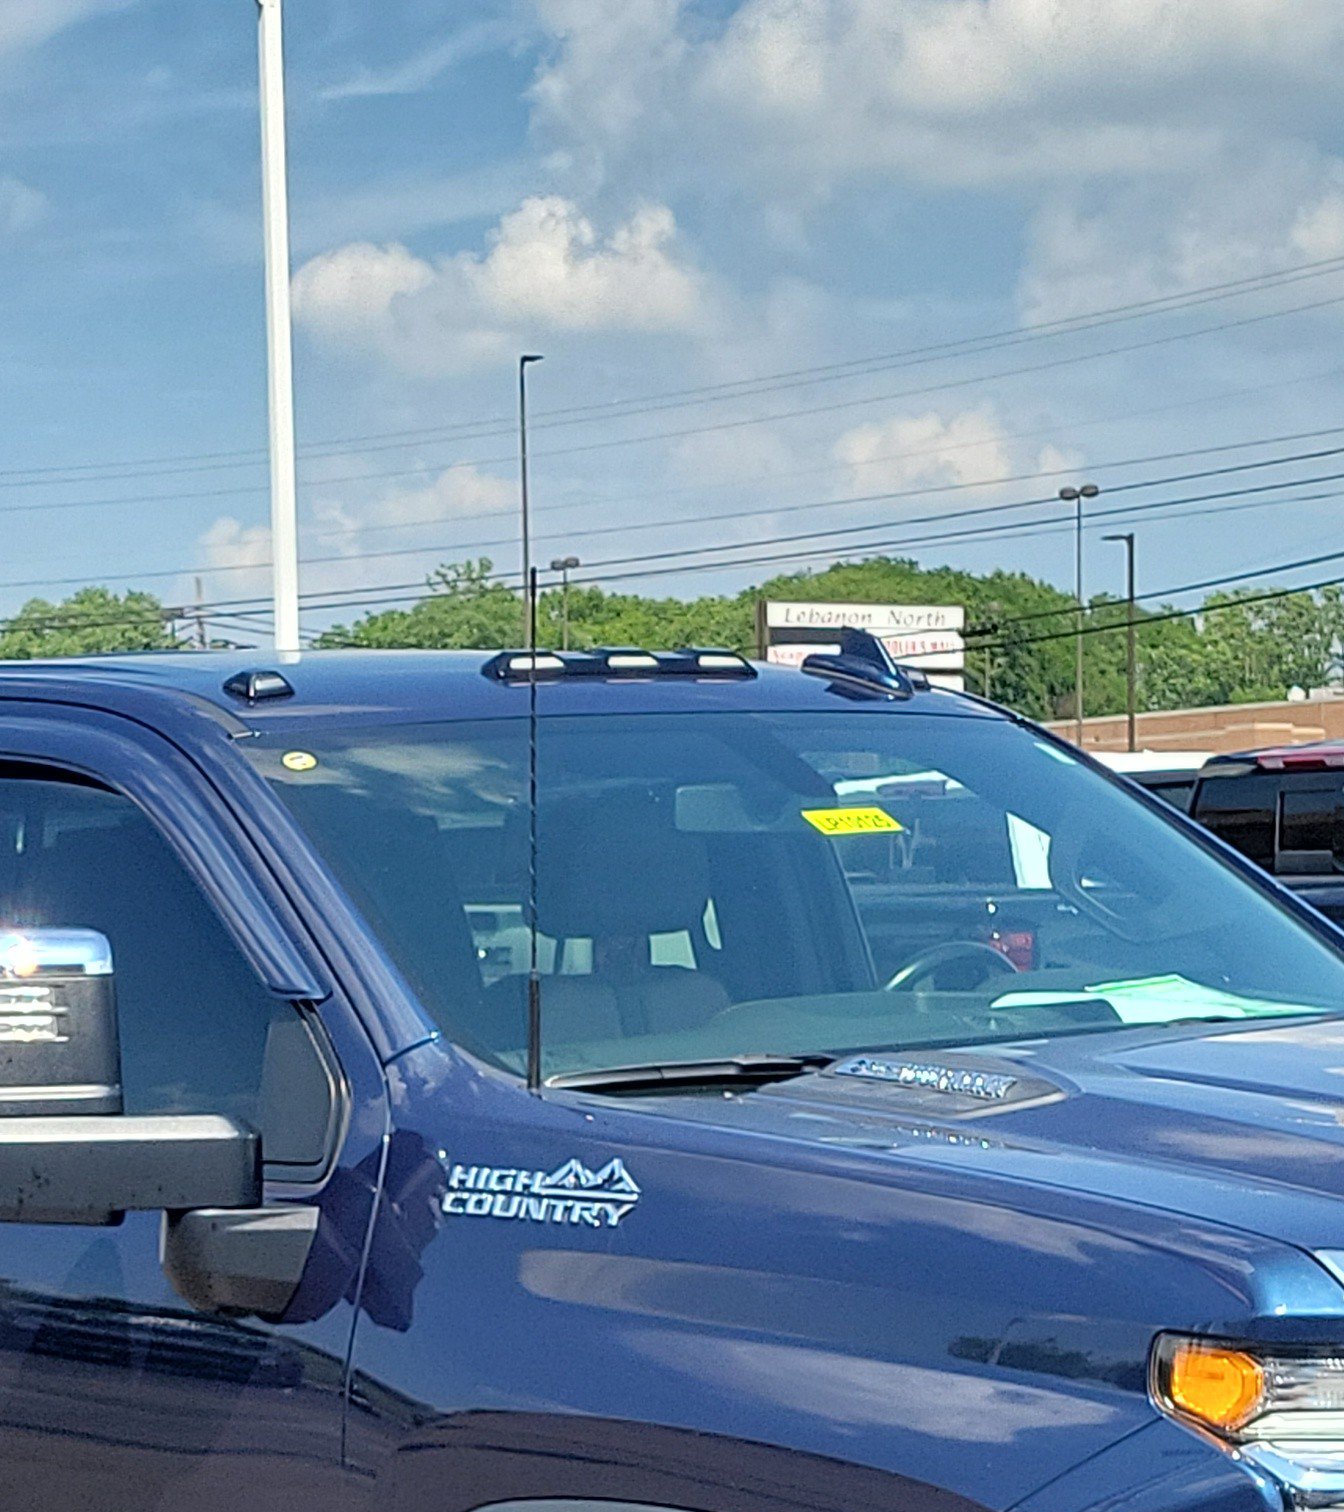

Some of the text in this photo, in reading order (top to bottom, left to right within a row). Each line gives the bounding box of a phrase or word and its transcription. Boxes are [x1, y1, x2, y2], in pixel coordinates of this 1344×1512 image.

[784, 607, 947, 627] Lebanon North
[448, 1164, 544, 1195] HIGH
[441, 1191, 638, 1228] COUNTRY
